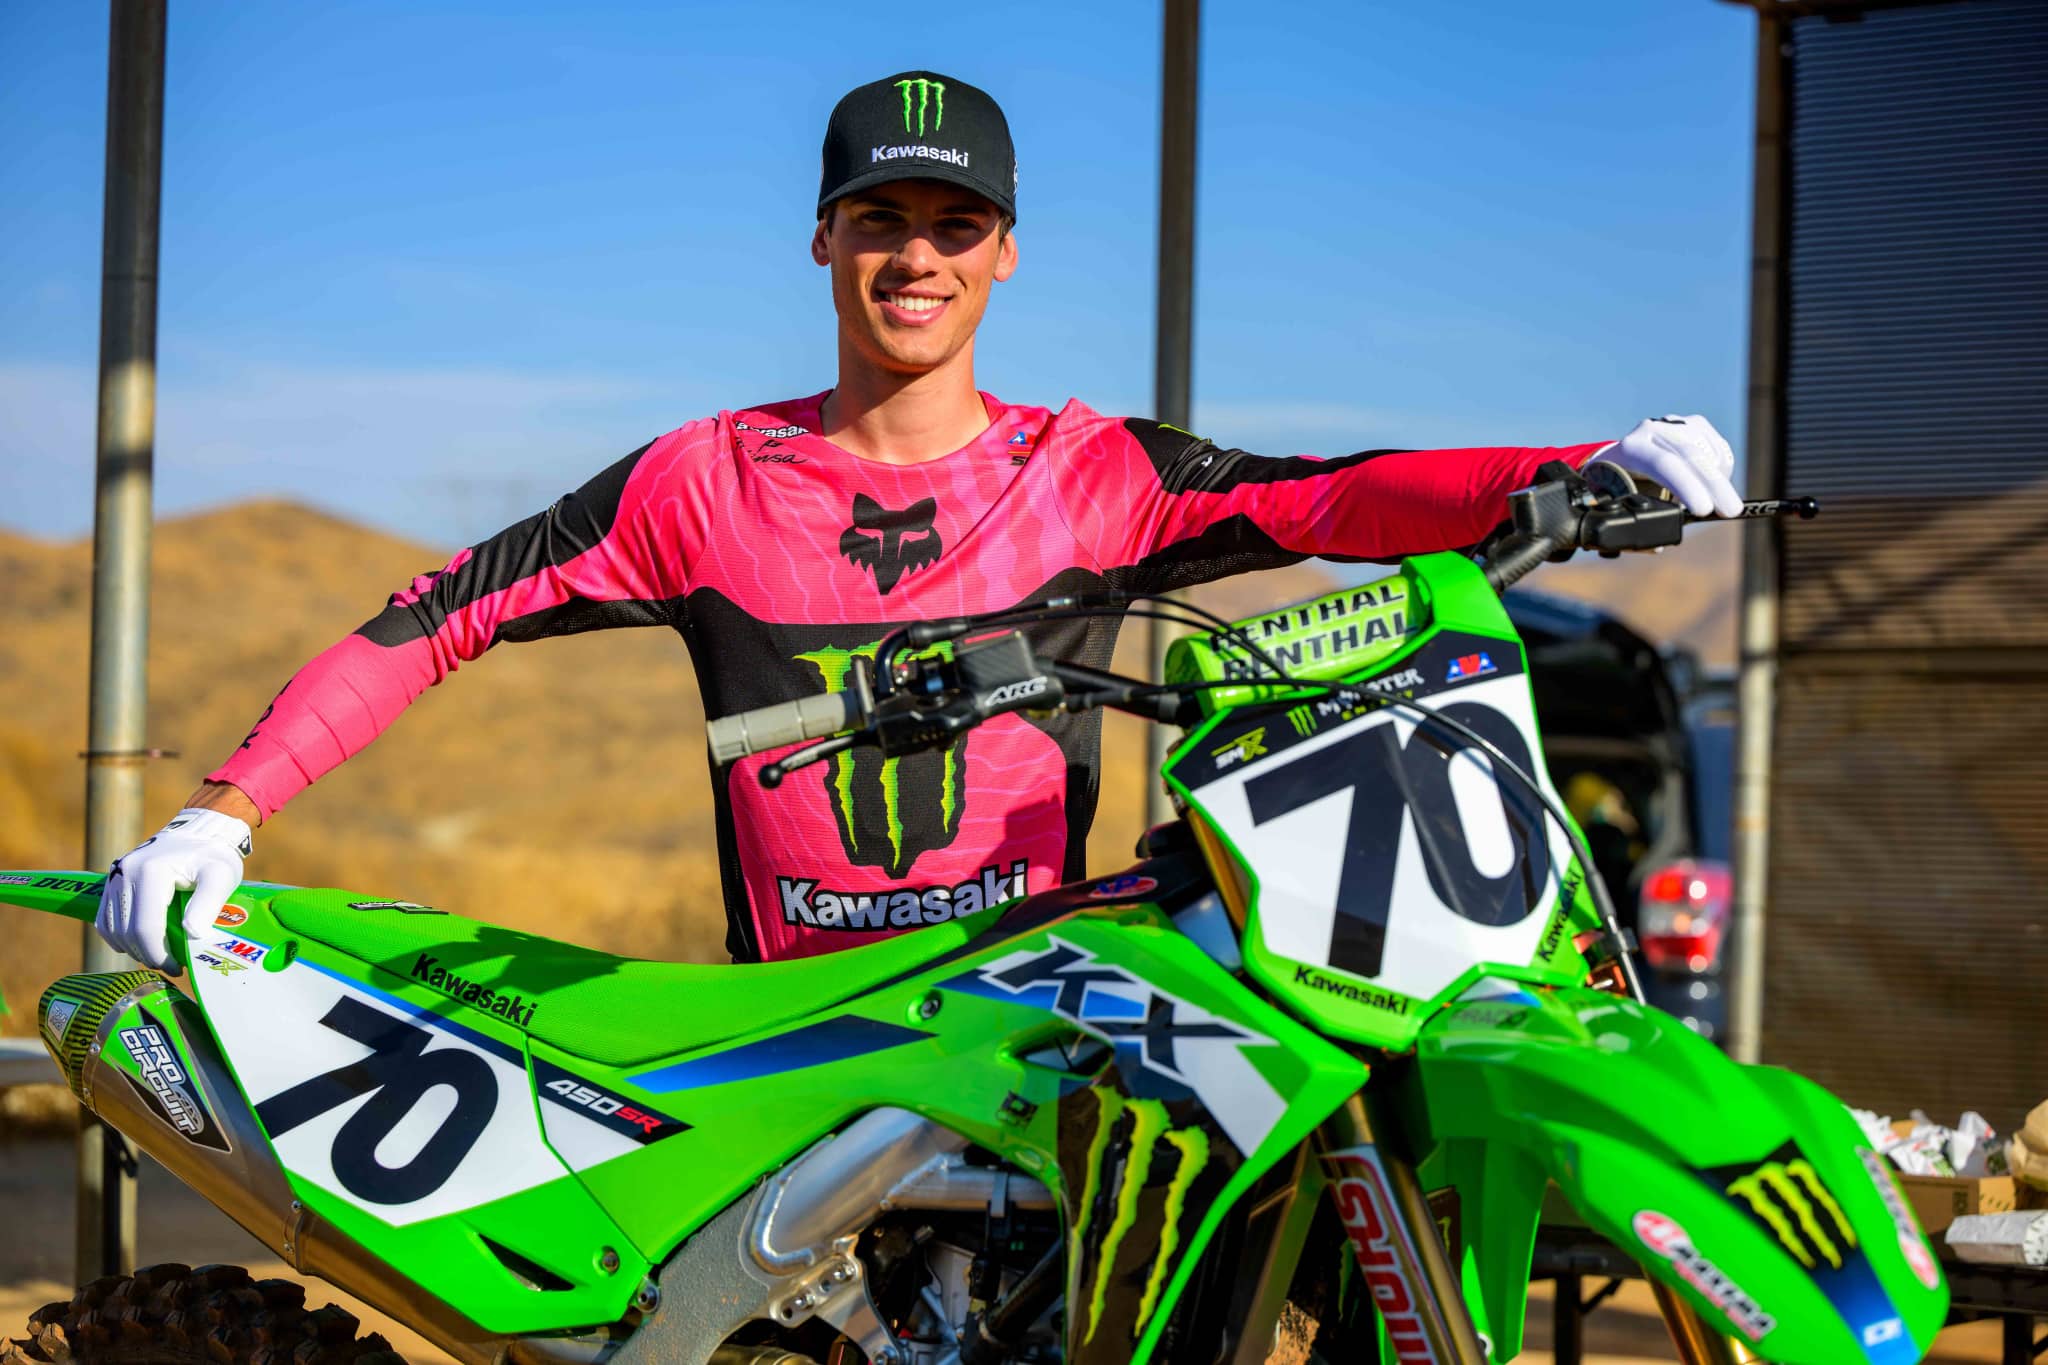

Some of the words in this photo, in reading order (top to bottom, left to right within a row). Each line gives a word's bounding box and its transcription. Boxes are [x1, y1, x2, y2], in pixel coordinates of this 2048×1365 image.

[871, 144, 969, 168] Kawasaki
[1742, 500, 1781, 516] RC
[984, 675, 1048, 707] ARC
[1243, 702, 1551, 978] 70
[31, 877, 105, 896] DUNL
[780, 861, 1028, 930] Kawasaki
[1538, 869, 1583, 962] Kawasaki
[214, 940, 264, 962] AMA
[411, 952, 538, 1028] Kawasaki
[985, 940, 1262, 1080] KX
[1294, 965, 1409, 1016] Kawasaki
[119, 1030, 199, 1135] CIRCUIT
[140, 1026, 183, 1084] PRO
[254, 995, 499, 1205] 70
